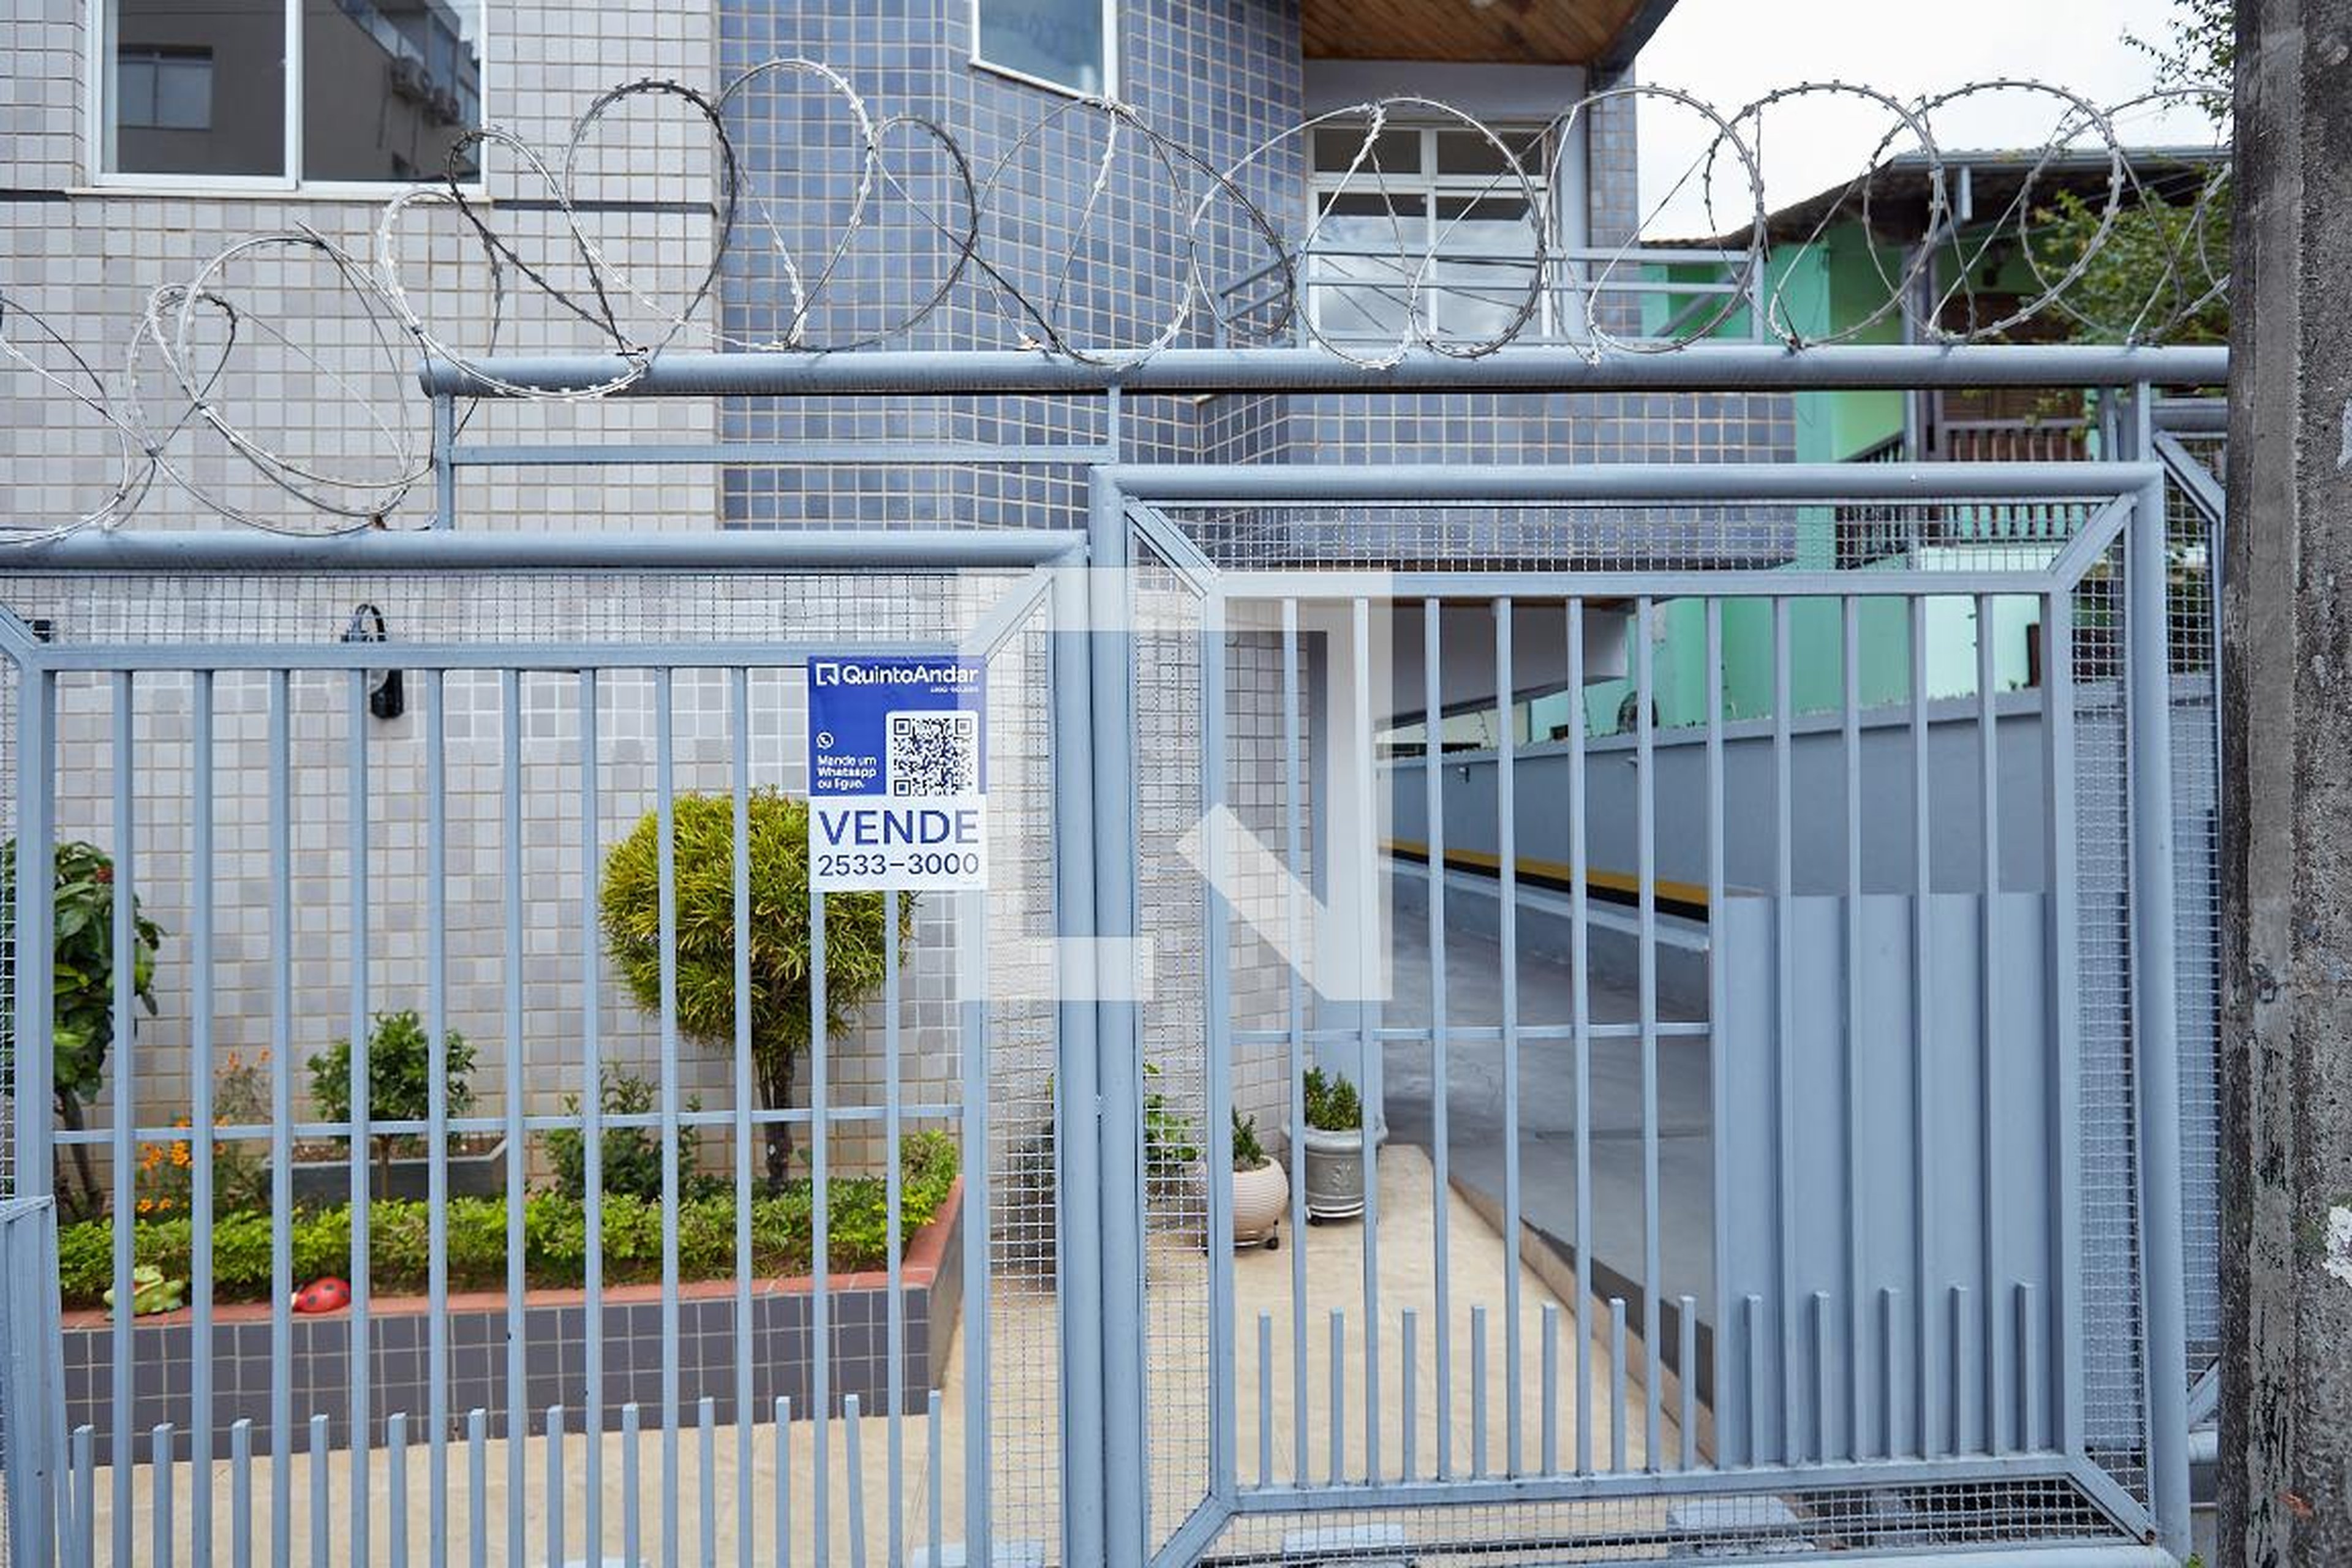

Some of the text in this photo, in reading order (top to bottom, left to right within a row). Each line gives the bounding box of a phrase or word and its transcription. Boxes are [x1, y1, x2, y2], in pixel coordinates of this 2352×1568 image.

[843, 665, 979, 684] QuintoAndar
[818, 810, 979, 845] VENDE
[818, 853, 979, 876] 2533-3000
